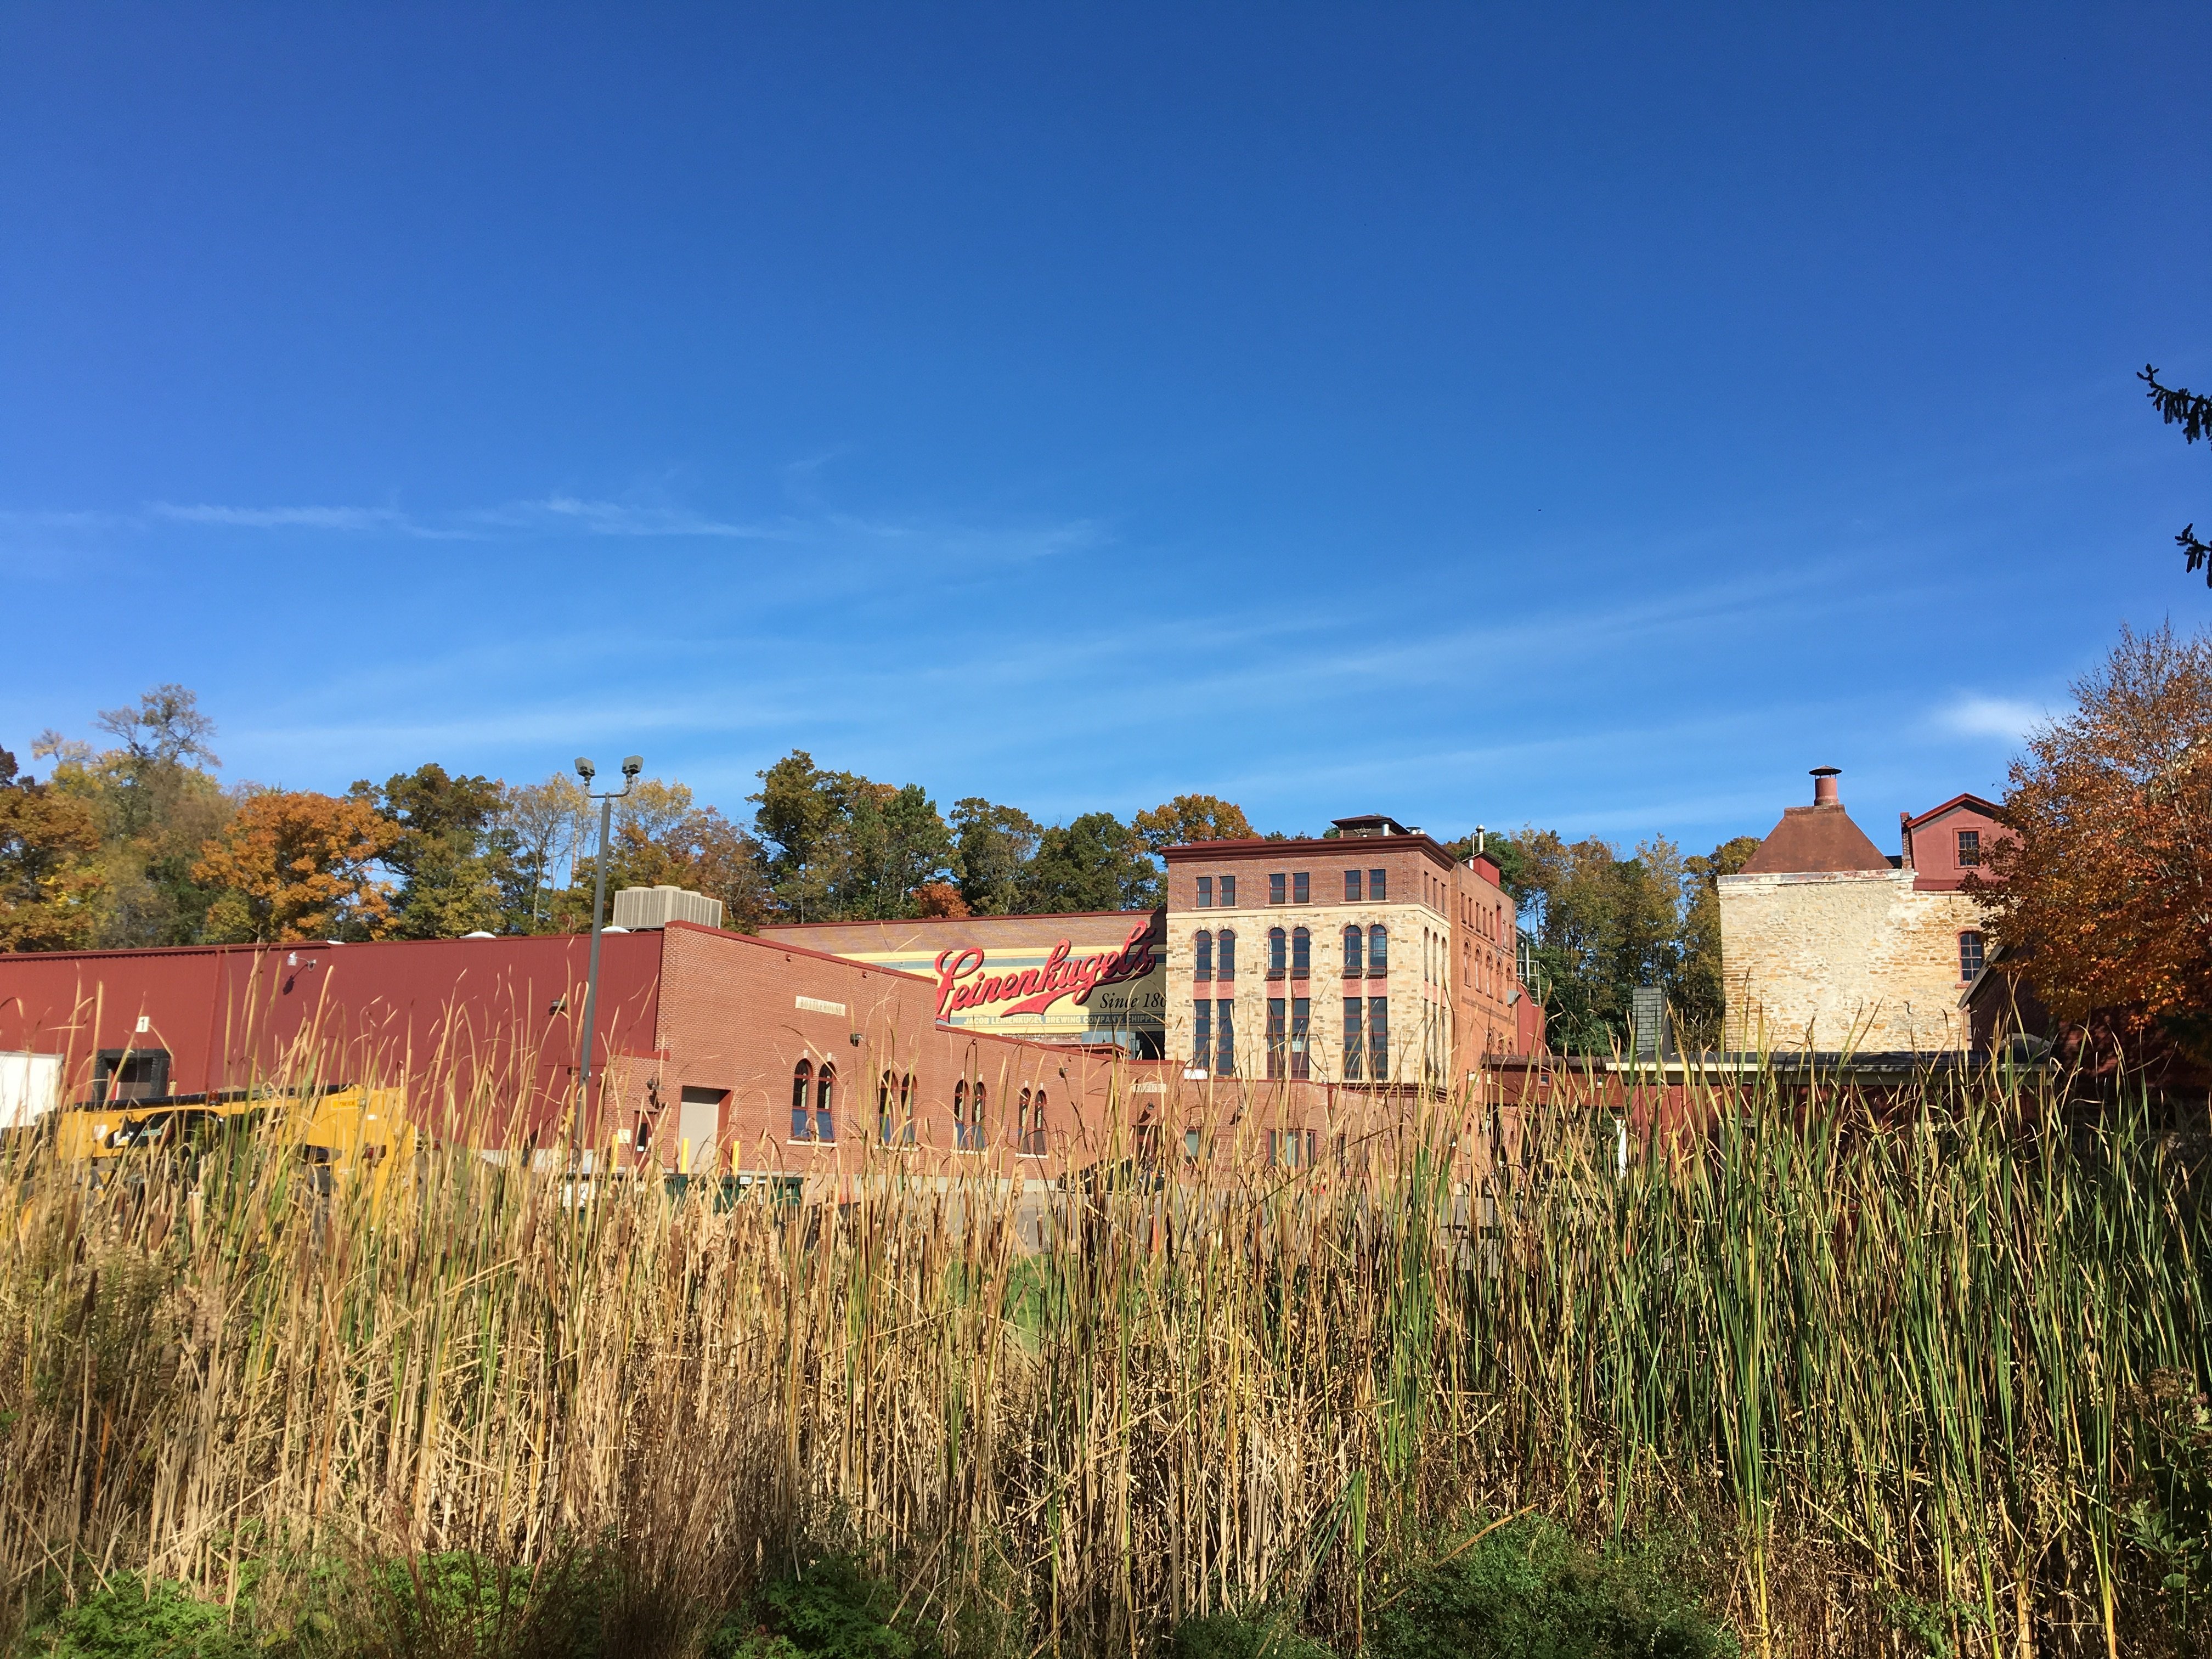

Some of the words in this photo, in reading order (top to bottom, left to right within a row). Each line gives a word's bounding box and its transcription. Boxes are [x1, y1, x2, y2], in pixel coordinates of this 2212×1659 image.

[934, 920, 1156, 1024] Leinenkugel's
[800, 998, 842, 1014] BOTTLEHOUSE
[1100, 992, 1139, 1009] Since
[991, 1016, 1043, 1024] LEINENKUGEL
[1045, 1015, 1081, 1024] BREWING
